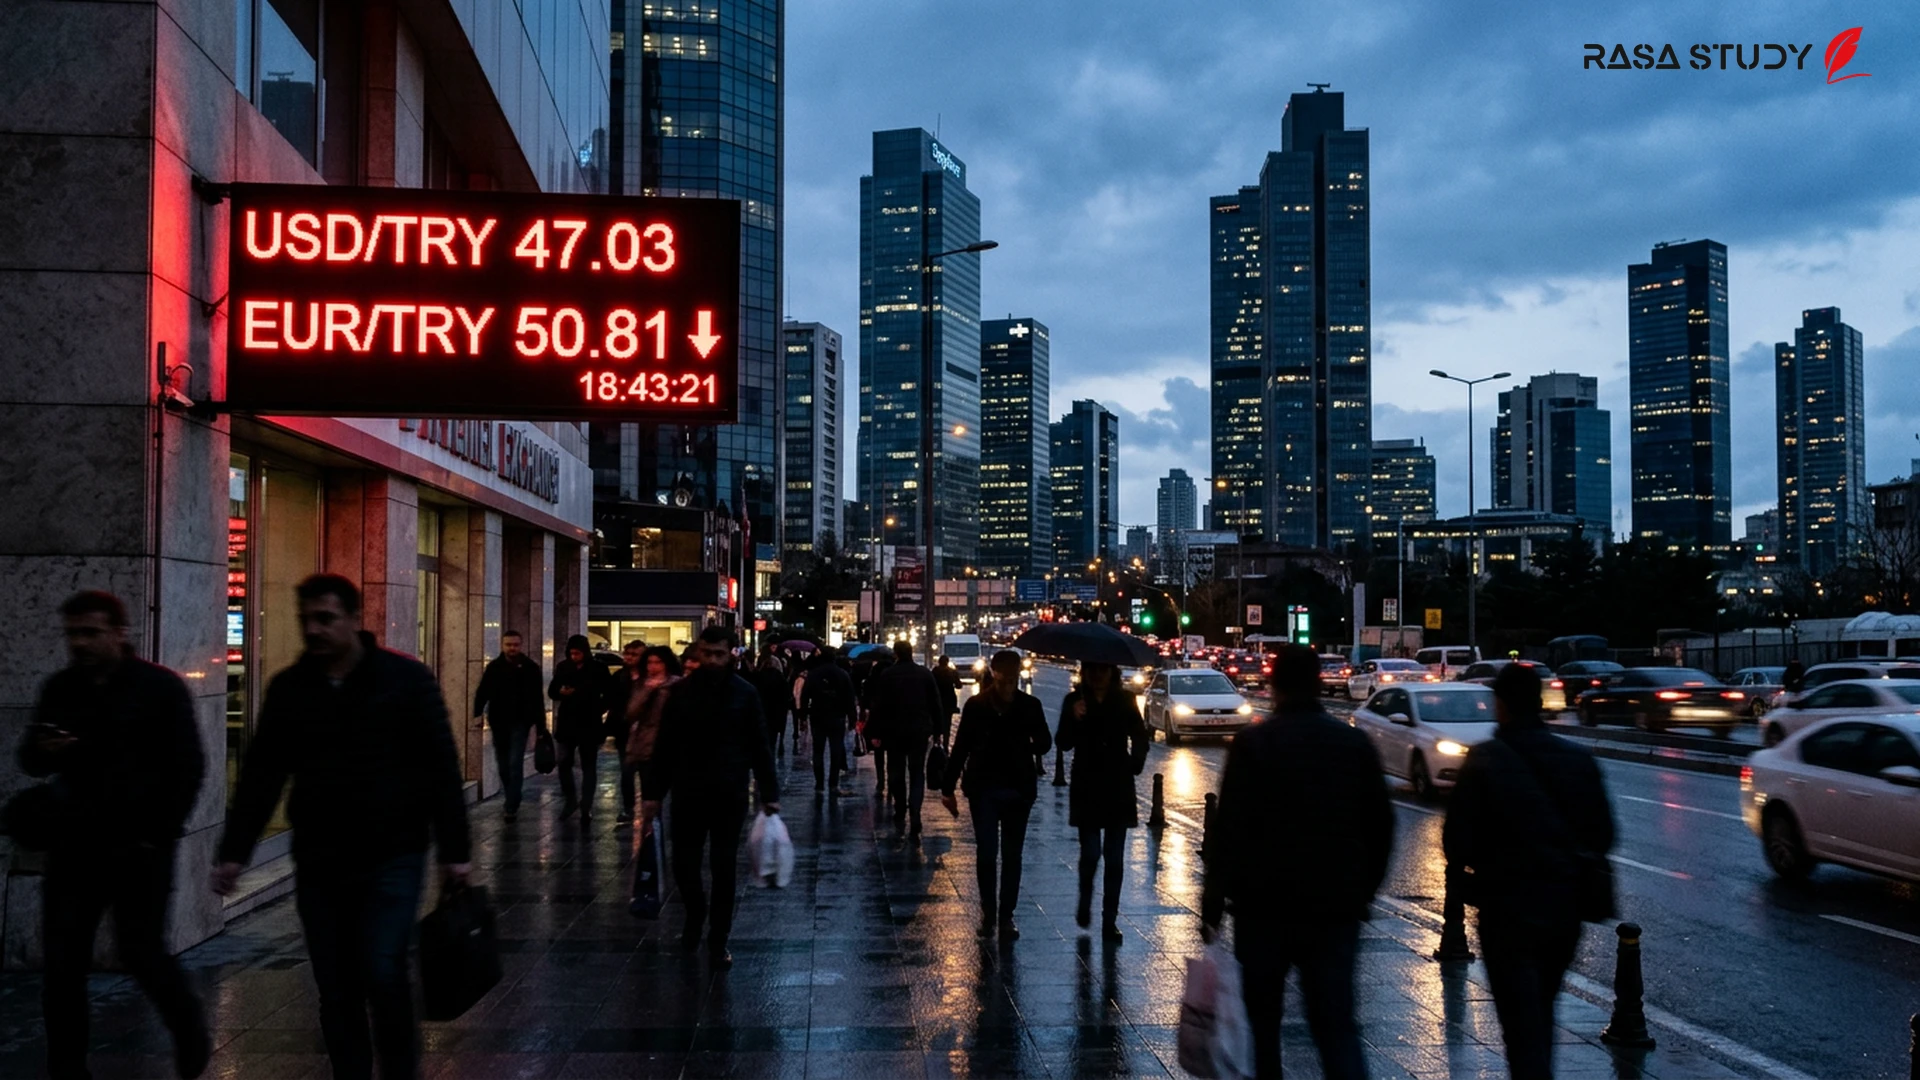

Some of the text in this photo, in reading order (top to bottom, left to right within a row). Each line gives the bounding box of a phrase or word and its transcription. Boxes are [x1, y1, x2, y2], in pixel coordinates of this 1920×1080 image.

[246, 210, 675, 272] USD/TRY 47.03
[244, 300, 667, 360] EUR/TRY 50.81
[579, 371, 716, 403] 18:43:21
